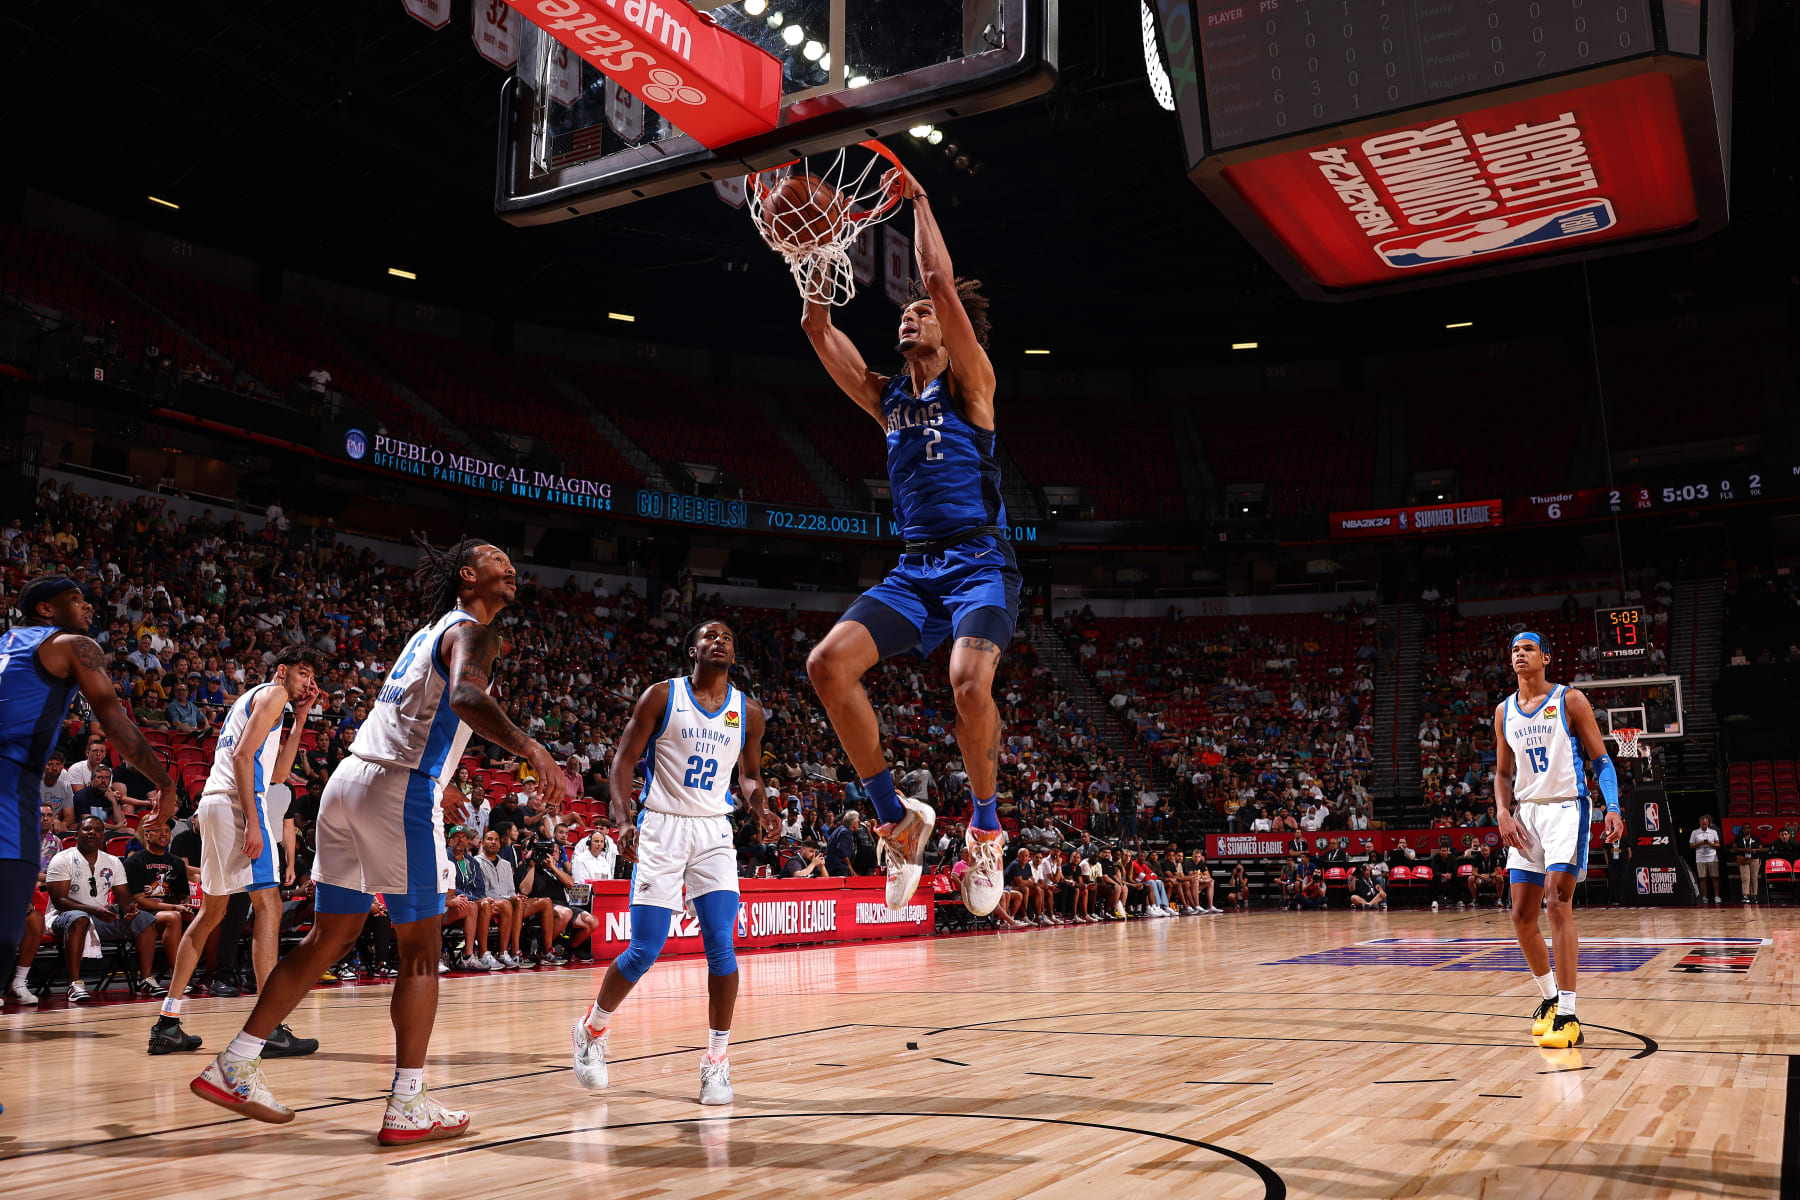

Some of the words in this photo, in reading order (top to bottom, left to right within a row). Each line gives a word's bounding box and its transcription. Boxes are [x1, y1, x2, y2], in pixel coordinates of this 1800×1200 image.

[486, 0, 508, 32] 32
[1208, 8, 1243, 26] PLAYER
[1260, 0, 1278, 12] PTS
[1488, 12, 1498, 28] 0
[1530, 2, 1540, 18] 0
[1266, 20, 1276, 35] 0
[1305, 10, 1312, 25] 1
[1490, 36, 1502, 54] 0
[1532, 26, 1543, 43] 0
[1576, 16, 1586, 32] 0
[1616, 6, 1627, 23] 0
[537, 0, 656, 71] State
[1269, 42, 1278, 58] 0
[1306, 32, 1316, 48] 0
[1344, 23, 1353, 38] 0
[1380, 14, 1390, 30] 2
[1272, 66, 1281, 82] 0
[1308, 57, 1318, 72] 0
[1346, 47, 1356, 64] 0
[1383, 38, 1393, 54] 0
[1494, 60, 1504, 77] 0
[1536, 50, 1546, 68] 2
[1578, 40, 1589, 58] 0
[1620, 31, 1630, 48] 0
[1274, 88, 1284, 104] 6
[1311, 80, 1321, 96] 3
[1349, 71, 1358, 86] 0
[1386, 62, 1396, 78] 0
[1276, 112, 1286, 128] 0
[1313, 103, 1323, 119] 0
[1352, 94, 1360, 110] 1
[1388, 85, 1398, 102] 0
[1471, 111, 1599, 207] LEAGUE
[1361, 119, 1499, 226] SUMMER
[1309, 146, 1399, 237] NBA2K24
[1558, 211, 1599, 234] NBA
[346, 439, 365, 454] PMI
[923, 427, 944, 461] 2
[374, 434, 444, 465] PUEBLO
[448, 453, 529, 484] MEDICAL
[533, 471, 612, 498] IMAGING
[374, 452, 427, 476] OFFICIAL
[433, 466, 485, 489] PARTNER
[491, 479, 505, 493] OF
[512, 483, 541, 500] UNLV
[546, 489, 612, 511] ATHLETICS
[1662, 483, 1710, 503] 5:03
[1721, 480, 1730, 491] 0
[1748, 474, 1761, 488] 2
[636, 489, 664, 518] GO
[667, 492, 748, 528] REBELS!
[1530, 493, 1574, 505] Thunder
[1608, 490, 1621, 504] 2
[1640, 489, 1649, 500] 3
[766, 510, 868, 535] 702.228.0031
[1342, 516, 1392, 529] NBA2K24
[1414, 508, 1455, 528] SUMMER
[1456, 505, 1490, 526] LEAGUE
[1547, 503, 1562, 520] 6
[1610, 610, 1638, 625] 5:03
[1616, 624, 1638, 646] 13
[392, 633, 428, 680] 6
[1613, 648, 1646, 657] TISSOT
[682, 728, 731, 746] OKLAHOMA
[1514, 725, 1552, 740] OKLAHOMA
[1526, 736, 1542, 746] CITY
[695, 742, 716, 754] CITY
[1526, 746, 1548, 774] 13
[684, 755, 718, 791] 22
[1227, 842, 1258, 855] SUMMER
[1258, 840, 1284, 854] LEAGUE
[1636, 836, 1670, 846] 2K24
[1650, 872, 1677, 883] SUMMER
[1652, 882, 1675, 894] LEAGUE
[751, 901, 798, 938] SUMMER
[800, 899, 837, 932] LEAGUE
